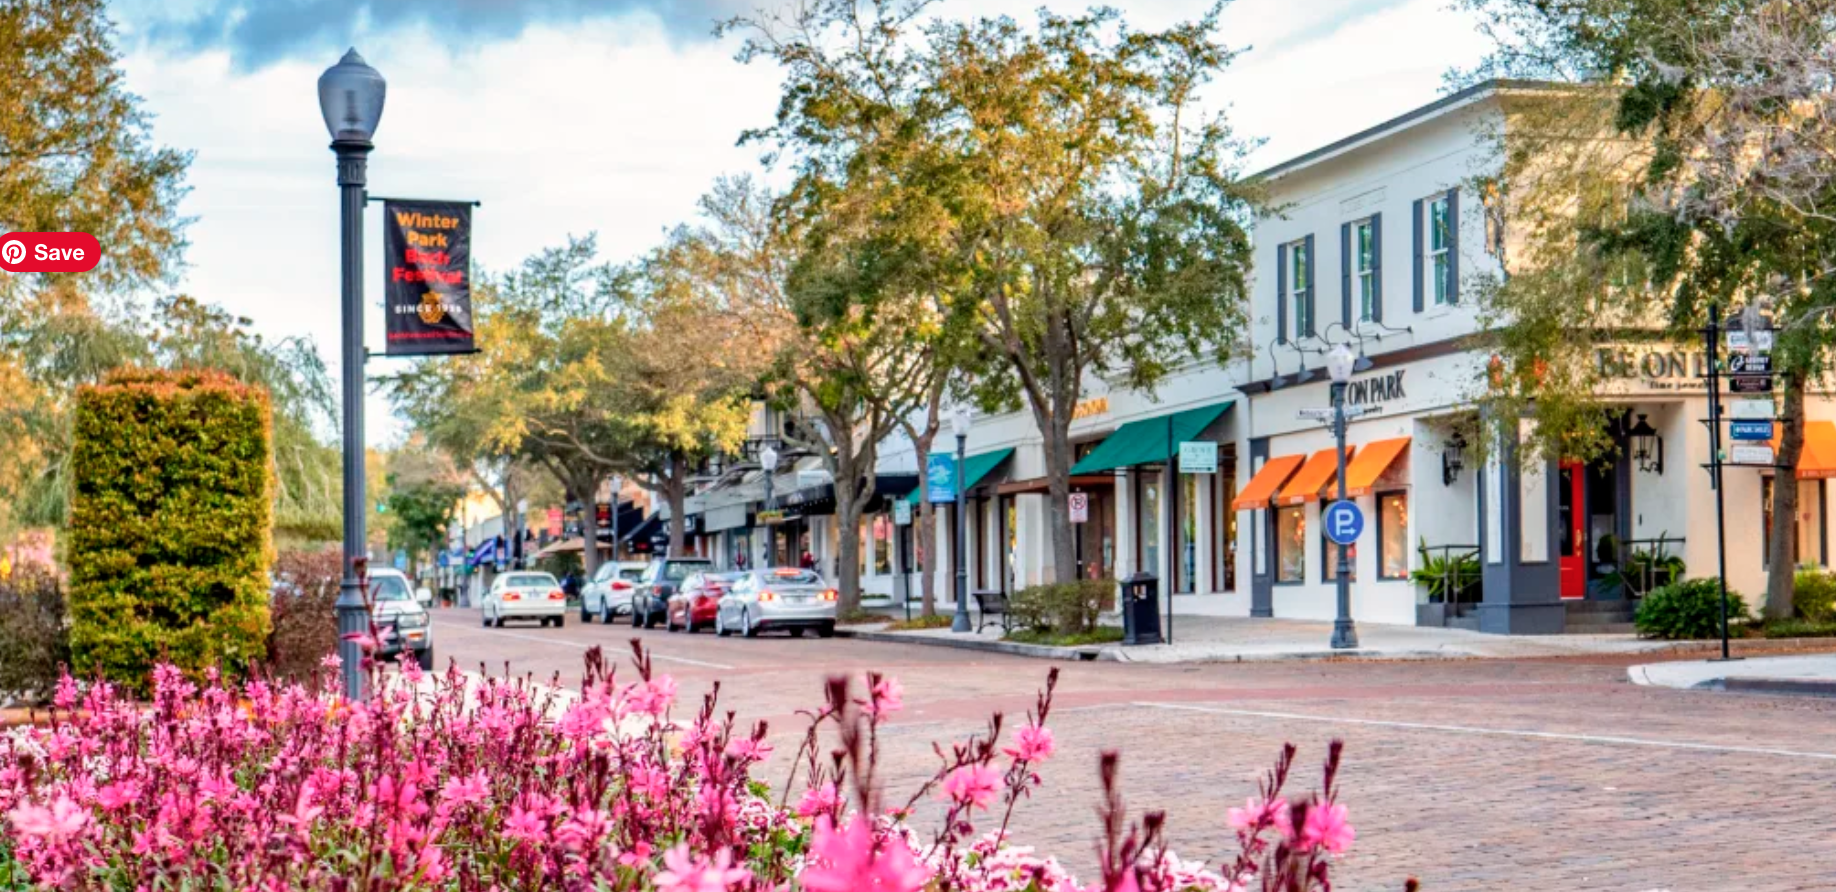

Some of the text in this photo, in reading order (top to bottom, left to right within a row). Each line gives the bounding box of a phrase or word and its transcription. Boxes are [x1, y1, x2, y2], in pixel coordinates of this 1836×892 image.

[396, 212, 459, 229] Winter
[406, 230, 447, 248] Park
[392, 266, 464, 285] Festival
[1641, 350, 1688, 379] ON
[1348, 380, 1368, 407] ON
[1370, 369, 1406, 404] PARK
